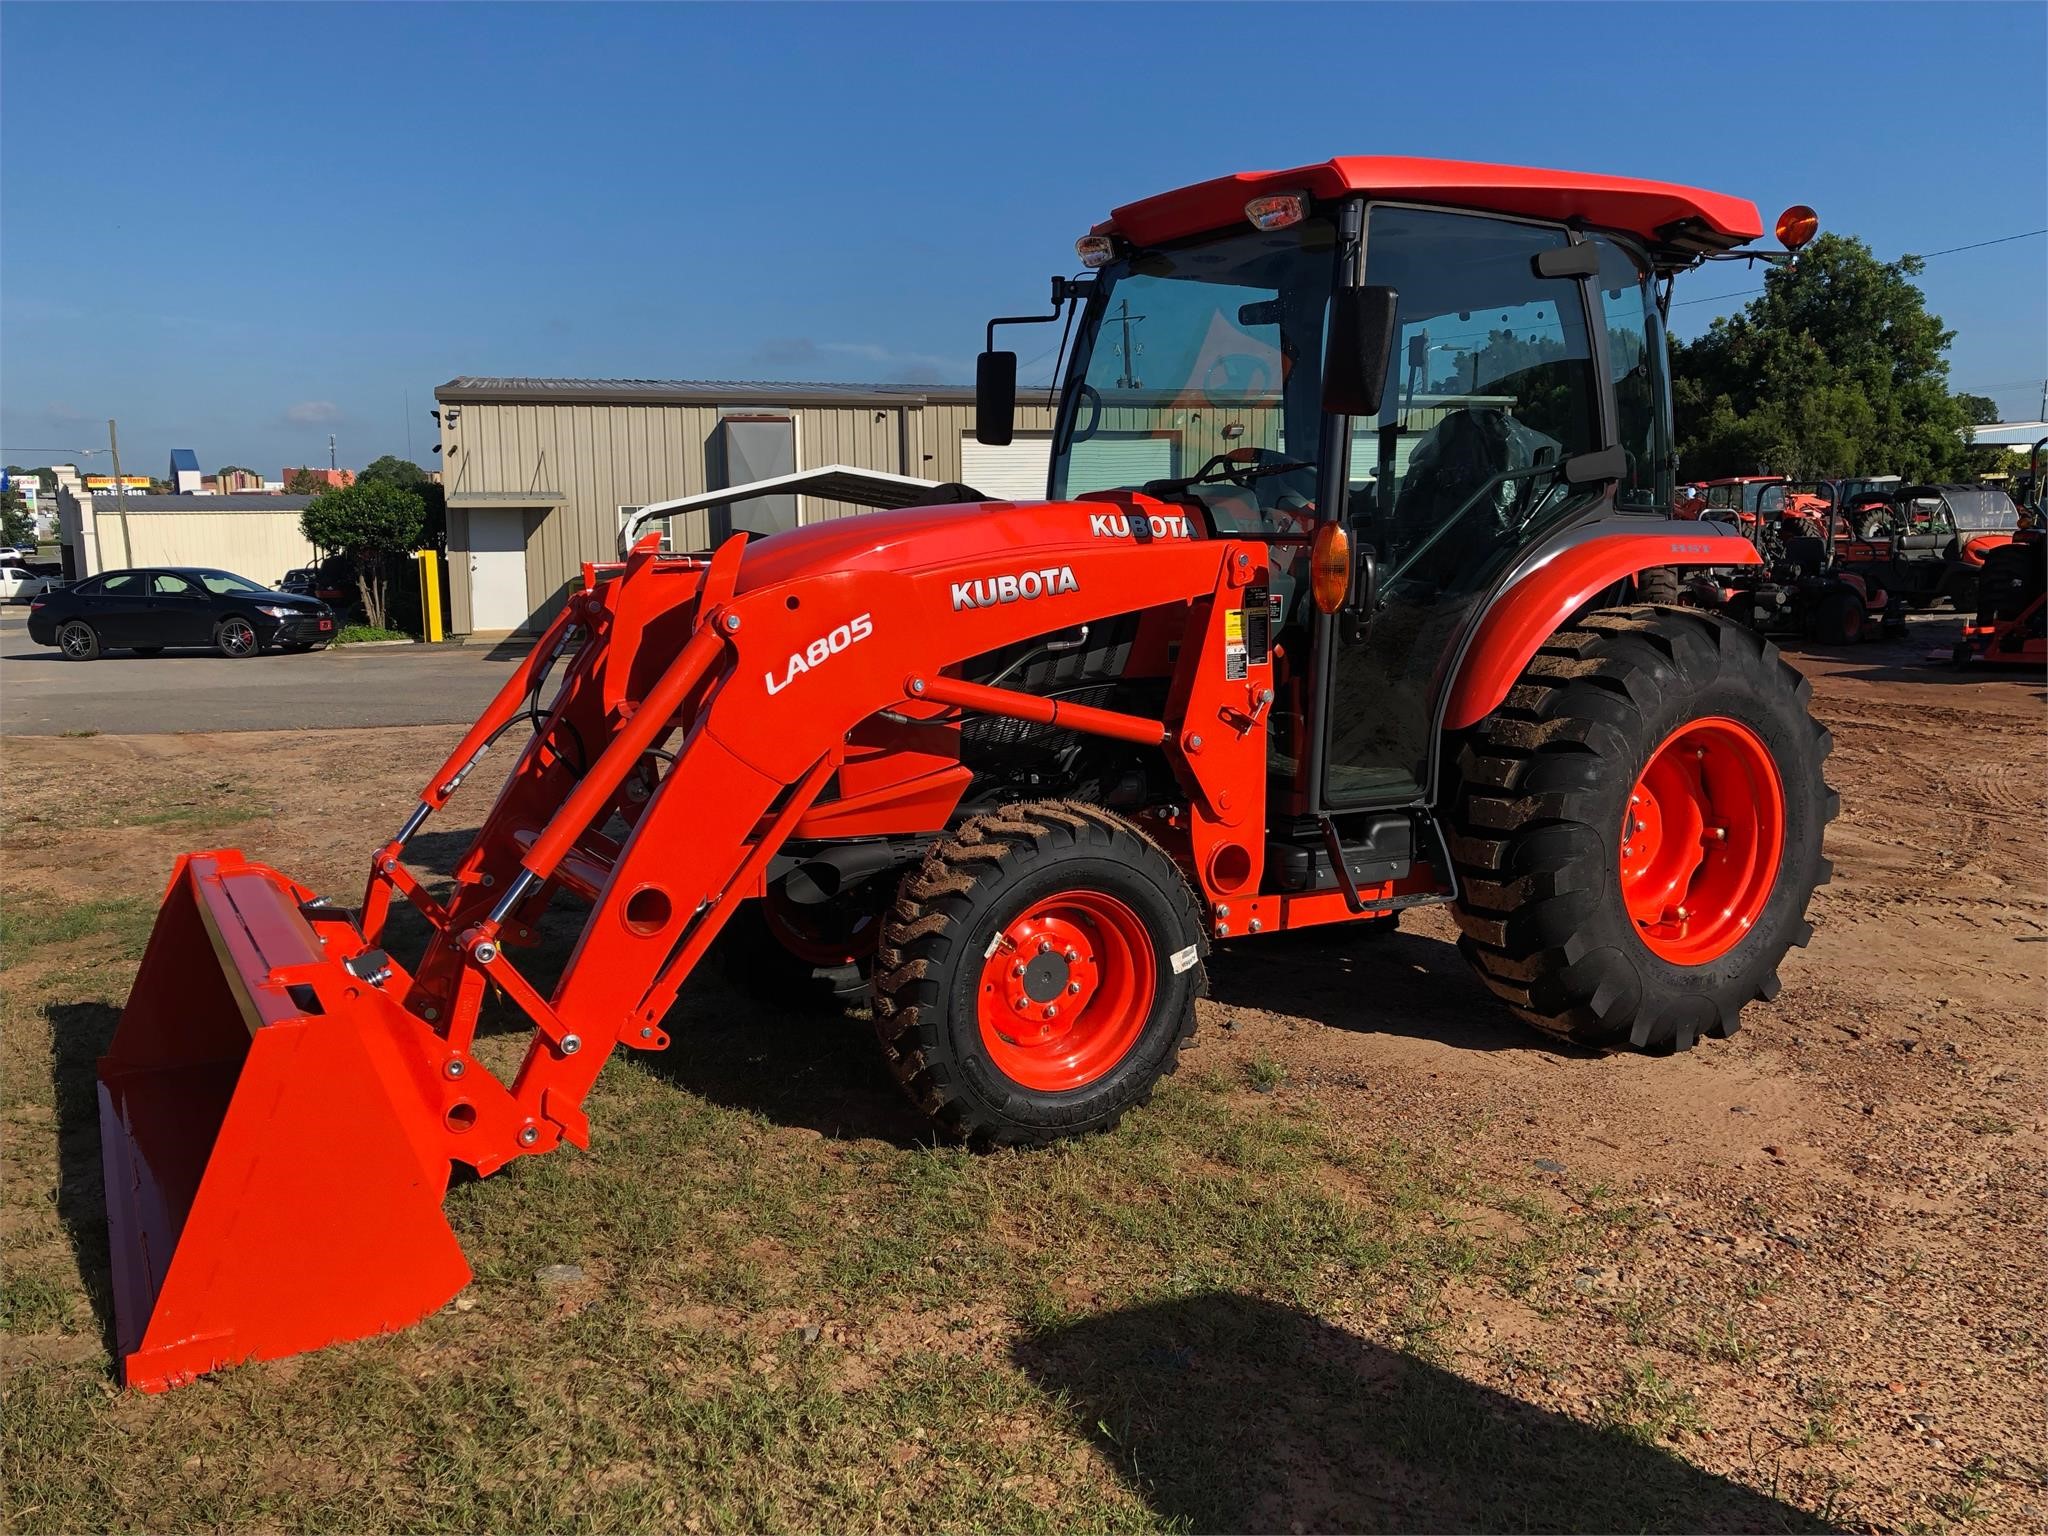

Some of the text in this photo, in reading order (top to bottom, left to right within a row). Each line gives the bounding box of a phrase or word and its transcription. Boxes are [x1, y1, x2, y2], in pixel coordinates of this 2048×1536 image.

[1090, 514, 1199, 538] KUBOTA
[951, 565, 1080, 611] KUBOTA
[765, 613, 873, 695] LA805
